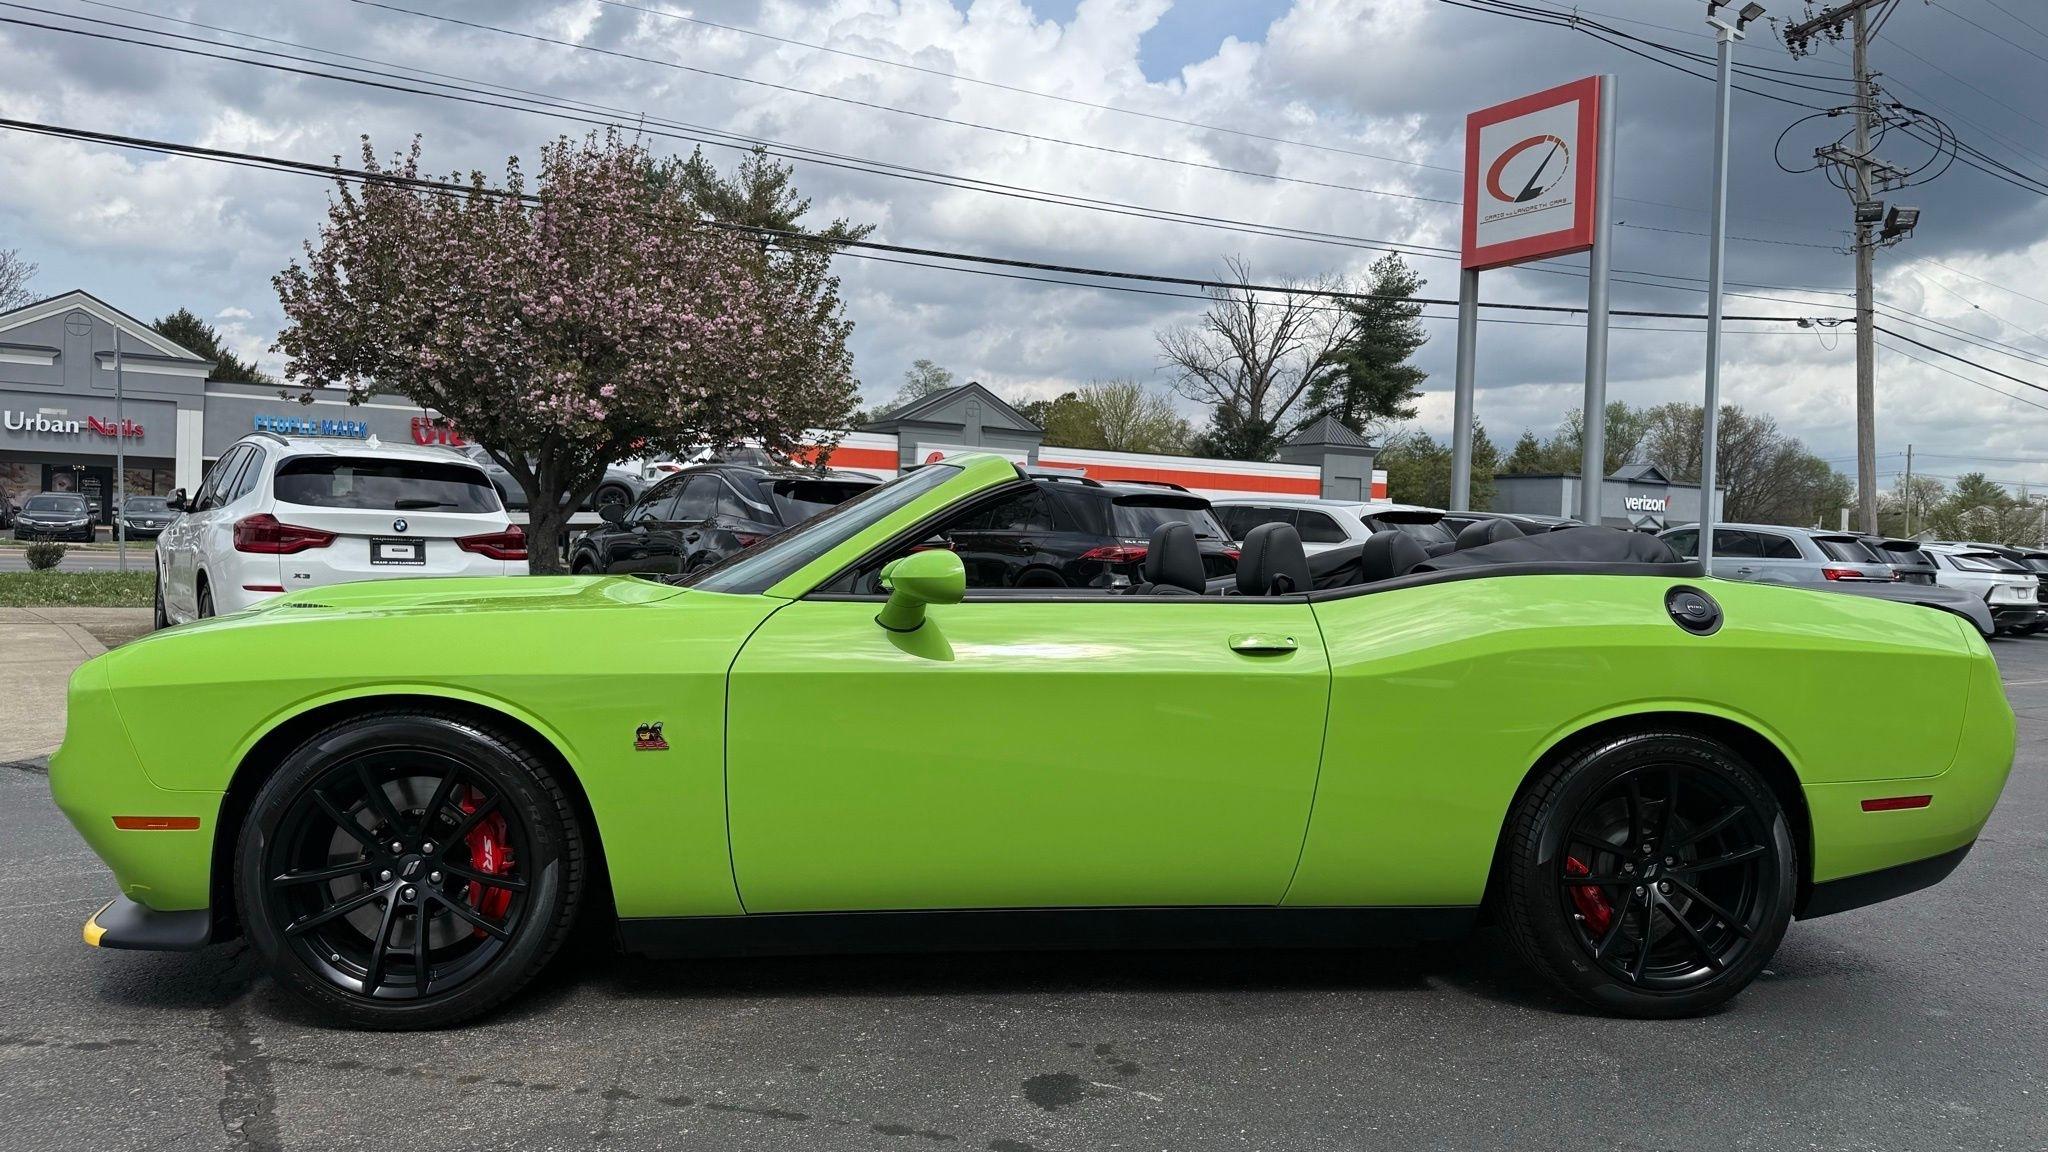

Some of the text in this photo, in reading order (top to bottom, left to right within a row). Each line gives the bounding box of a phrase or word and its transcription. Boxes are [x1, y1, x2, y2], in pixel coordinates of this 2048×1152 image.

[4, 410, 144, 437] Urban Nails
[253, 414, 368, 438] PEOPLE MARK
[1624, 494, 1666, 511] verizon
